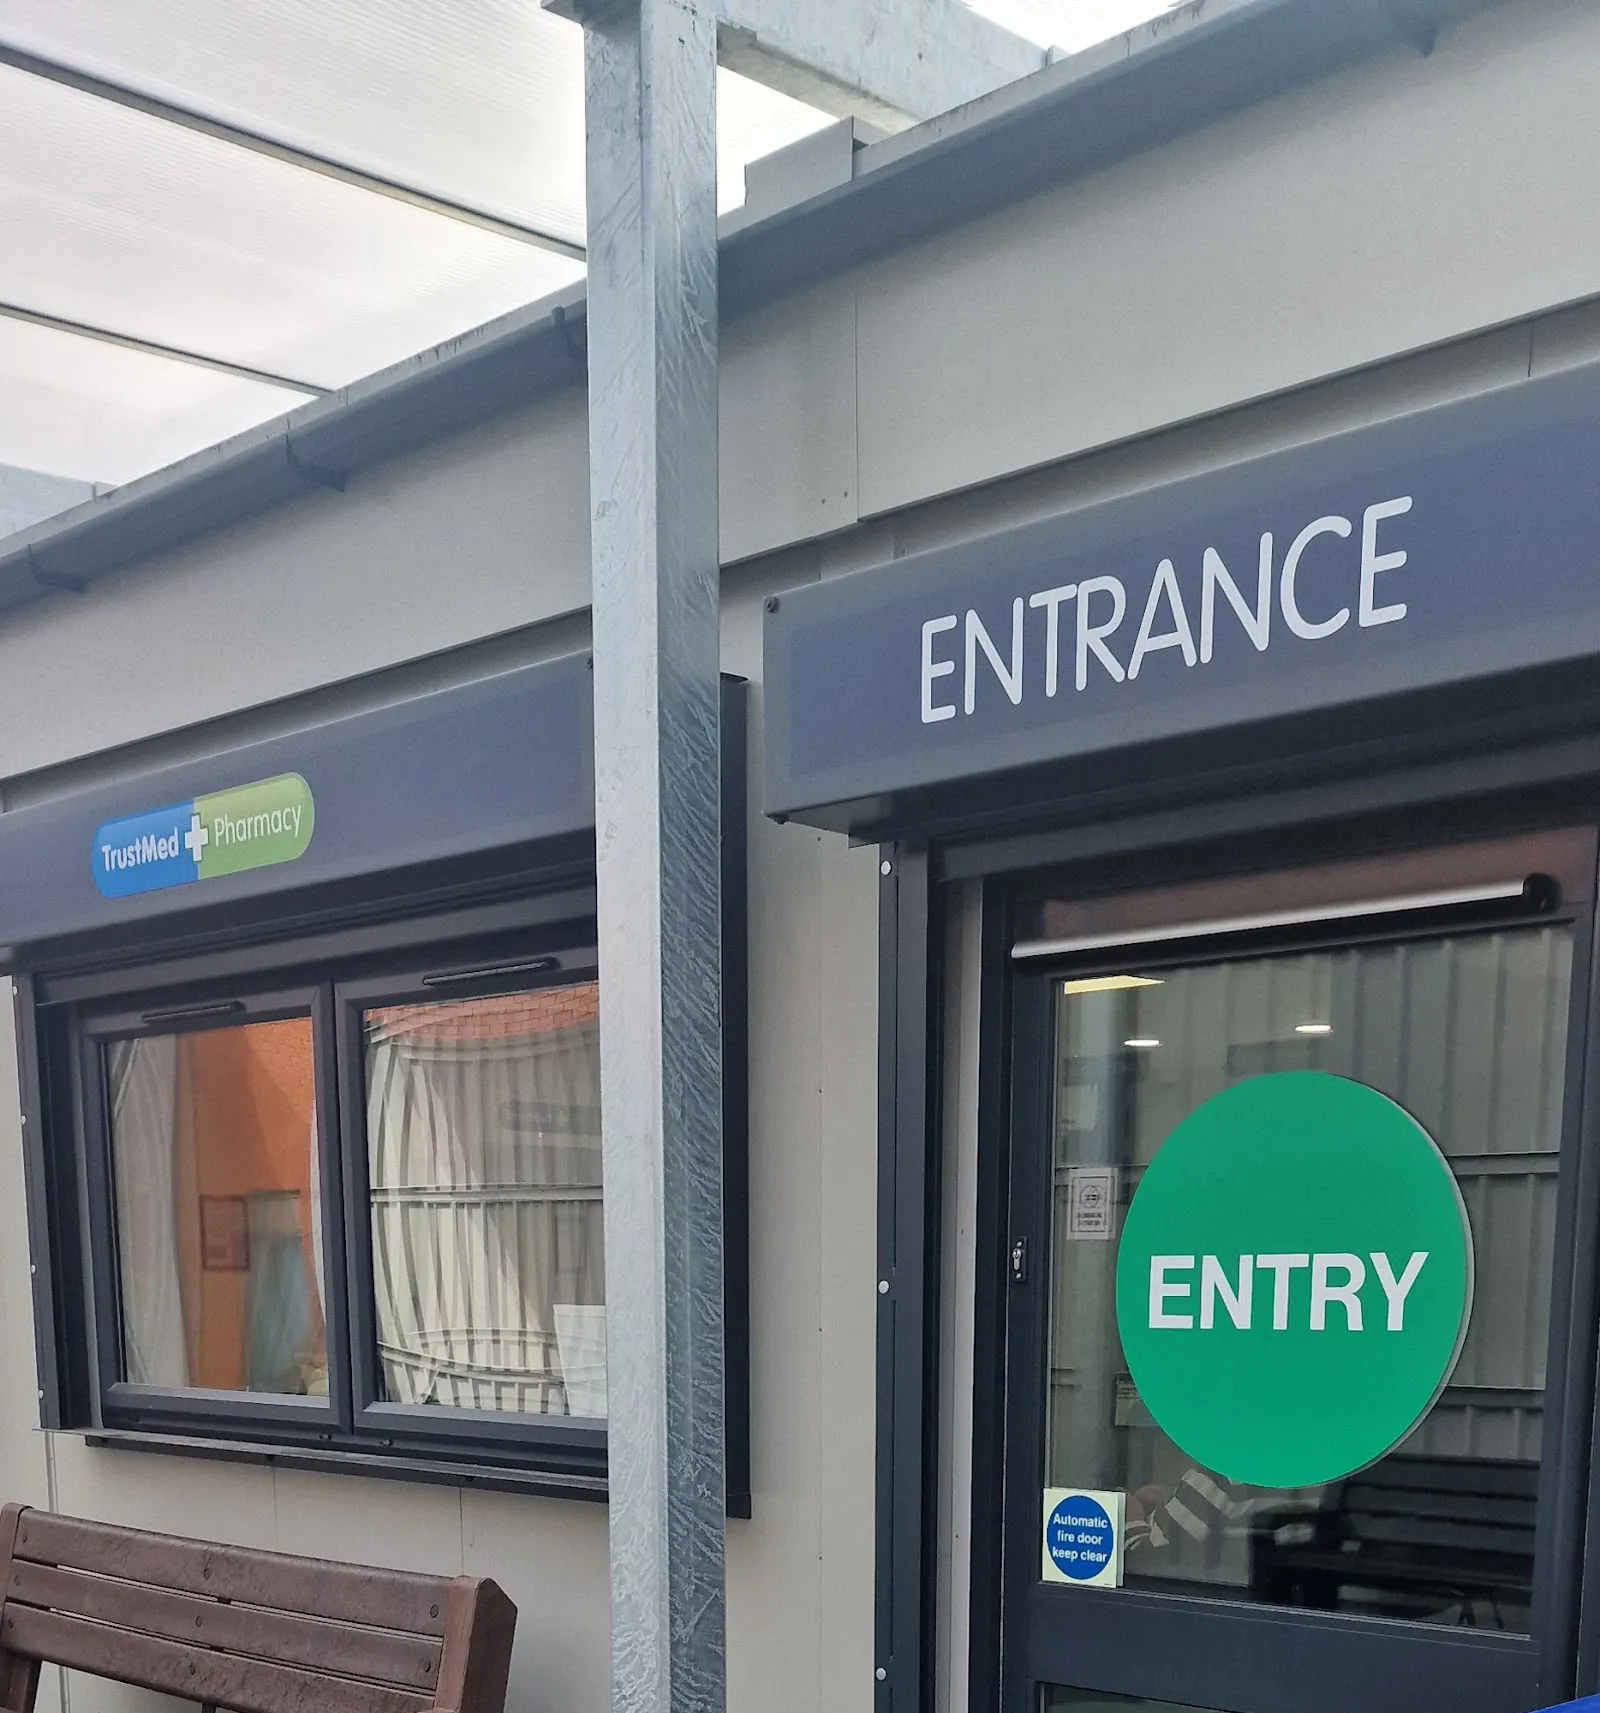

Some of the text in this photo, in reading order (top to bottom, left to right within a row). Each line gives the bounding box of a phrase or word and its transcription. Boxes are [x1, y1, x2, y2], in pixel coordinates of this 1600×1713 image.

[920, 495, 1414, 724] ENTRANCE
[101, 803, 302, 872] TrustMed Pharmacy
[1148, 1251, 1430, 1332] ENTRY
[1053, 1513, 1108, 1528] Automatic
[1057, 1530, 1103, 1545] fire door
[1052, 1546, 1107, 1562] keep clear
